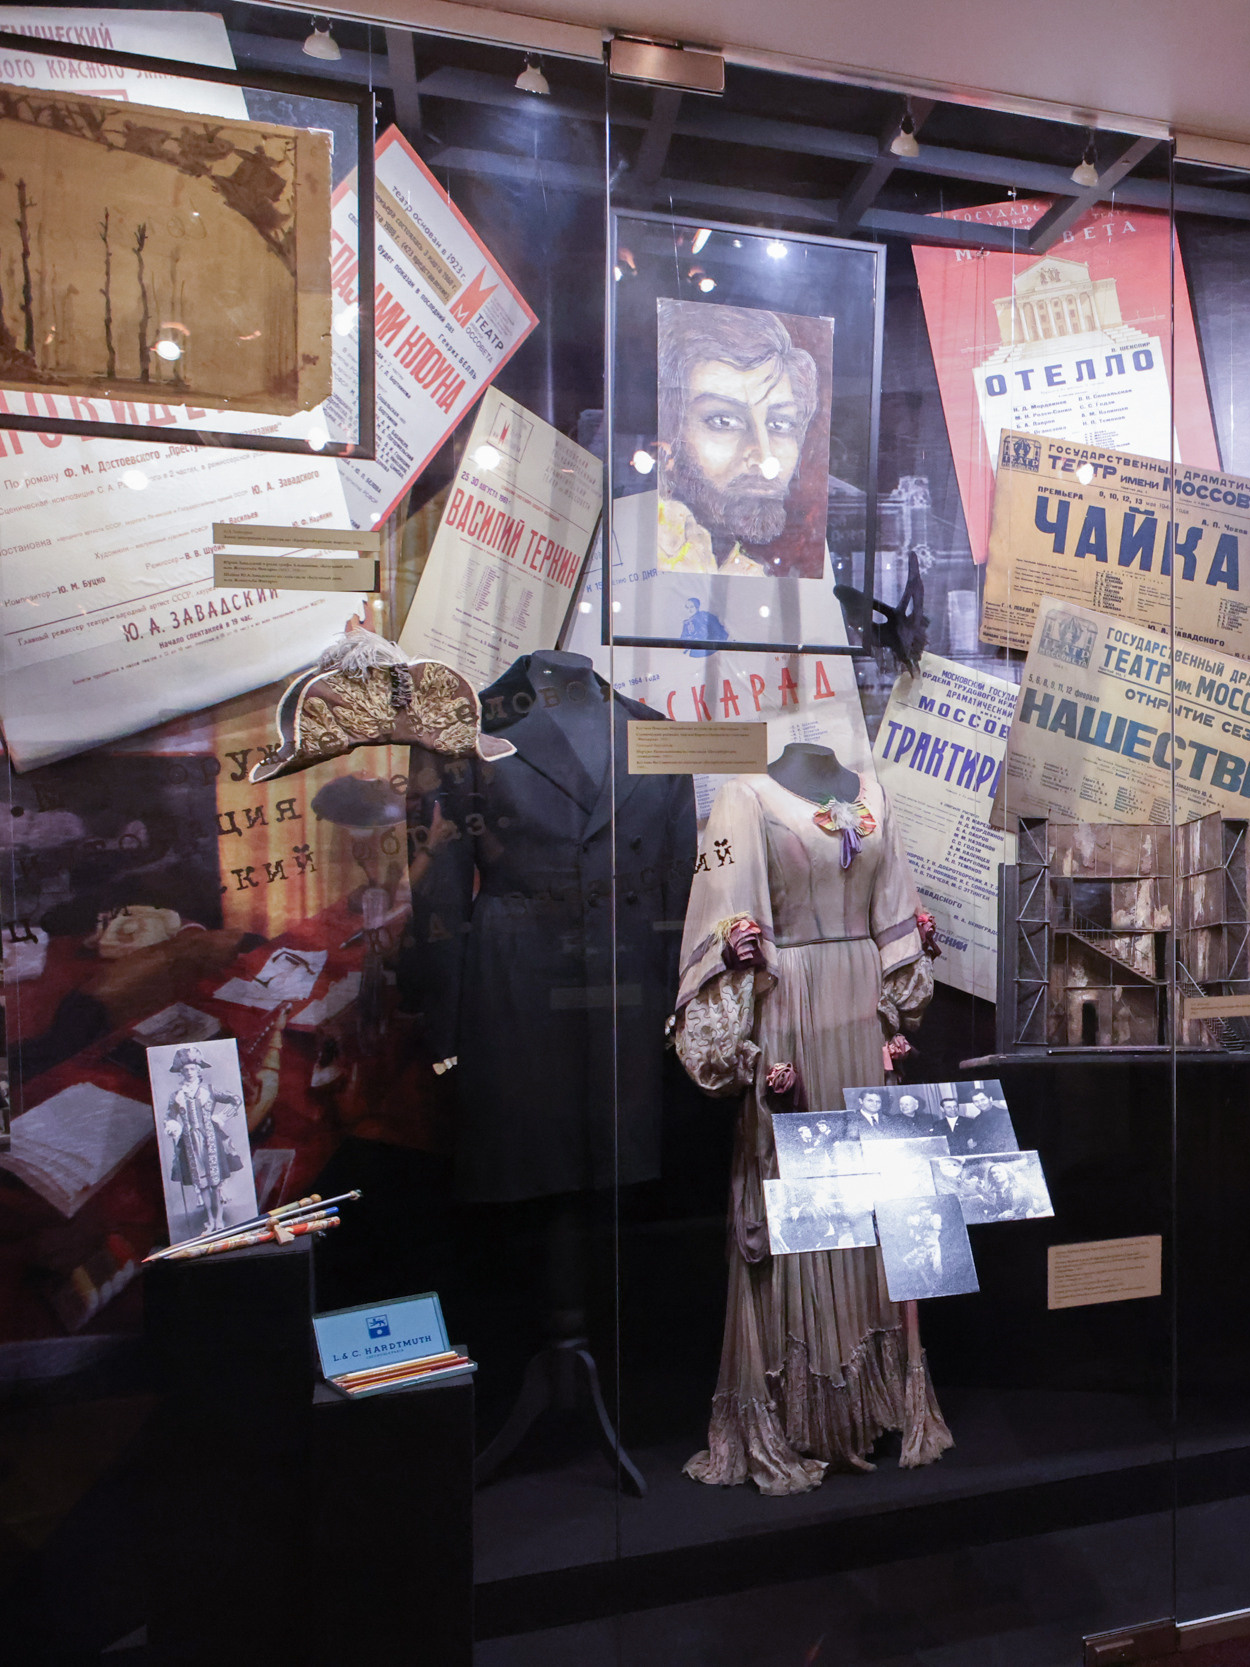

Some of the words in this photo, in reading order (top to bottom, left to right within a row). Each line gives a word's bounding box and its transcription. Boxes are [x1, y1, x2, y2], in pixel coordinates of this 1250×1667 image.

[412, 212, 442, 249] основан
[474, 312, 505, 350] ТЕАТР
[393, 324, 467, 415] КЛОУНА
[985, 348, 1154, 397] ОТЕЛЛО
[4, 477, 20, 491] По
[24, 471, 60, 489] роману
[63, 466, 75, 479] Ф.
[81, 463, 94, 477] М.
[98, 449, 161, 473] Достоевского
[251, 483, 263, 497] Ю.
[278, 469, 320, 490] Завадского
[1047, 454, 1118, 480] ТЕТР
[1120, 473, 1161, 491] ИМЕНИ
[1037, 484, 1084, 502] ПРЕМЬЕРА
[1135, 497, 1143, 506] 13
[444, 487, 527, 559] ВАСИЛИЙ
[522, 528, 582, 590] ТЕРКИН
[1033, 494, 1241, 592] ЧАЙКА
[18, 630, 50, 647] Главный
[51, 623, 84, 639] режиссер
[122, 621, 144, 644] Ю.
[150, 616, 166, 636] А.
[158, 636, 186, 650] Начало
[186, 623, 225, 640] спектаклей
[1174, 630, 1226, 648] АВАДСКОГО
[1103, 643, 1172, 686] ТЕАТР
[1105, 626, 1226, 678] ГОСУДАРСТВЕННЫЙ
[628, 675, 643, 687] 1964
[638, 660, 836, 722] СКАРАД
[921, 671, 951, 687] ОРДЕНА
[953, 682, 997, 703] ТРУДОВОГО
[941, 669, 986, 691] МОСКОВСКИЙ
[1074, 687, 1101, 704] февраля
[945, 689, 1014, 719] ДРАМАТИЧЕСКИЙ
[1124, 687, 1216, 729] ОТКРЫТИЕ
[365, 1334, 433, 1356] HARDTMUTH
